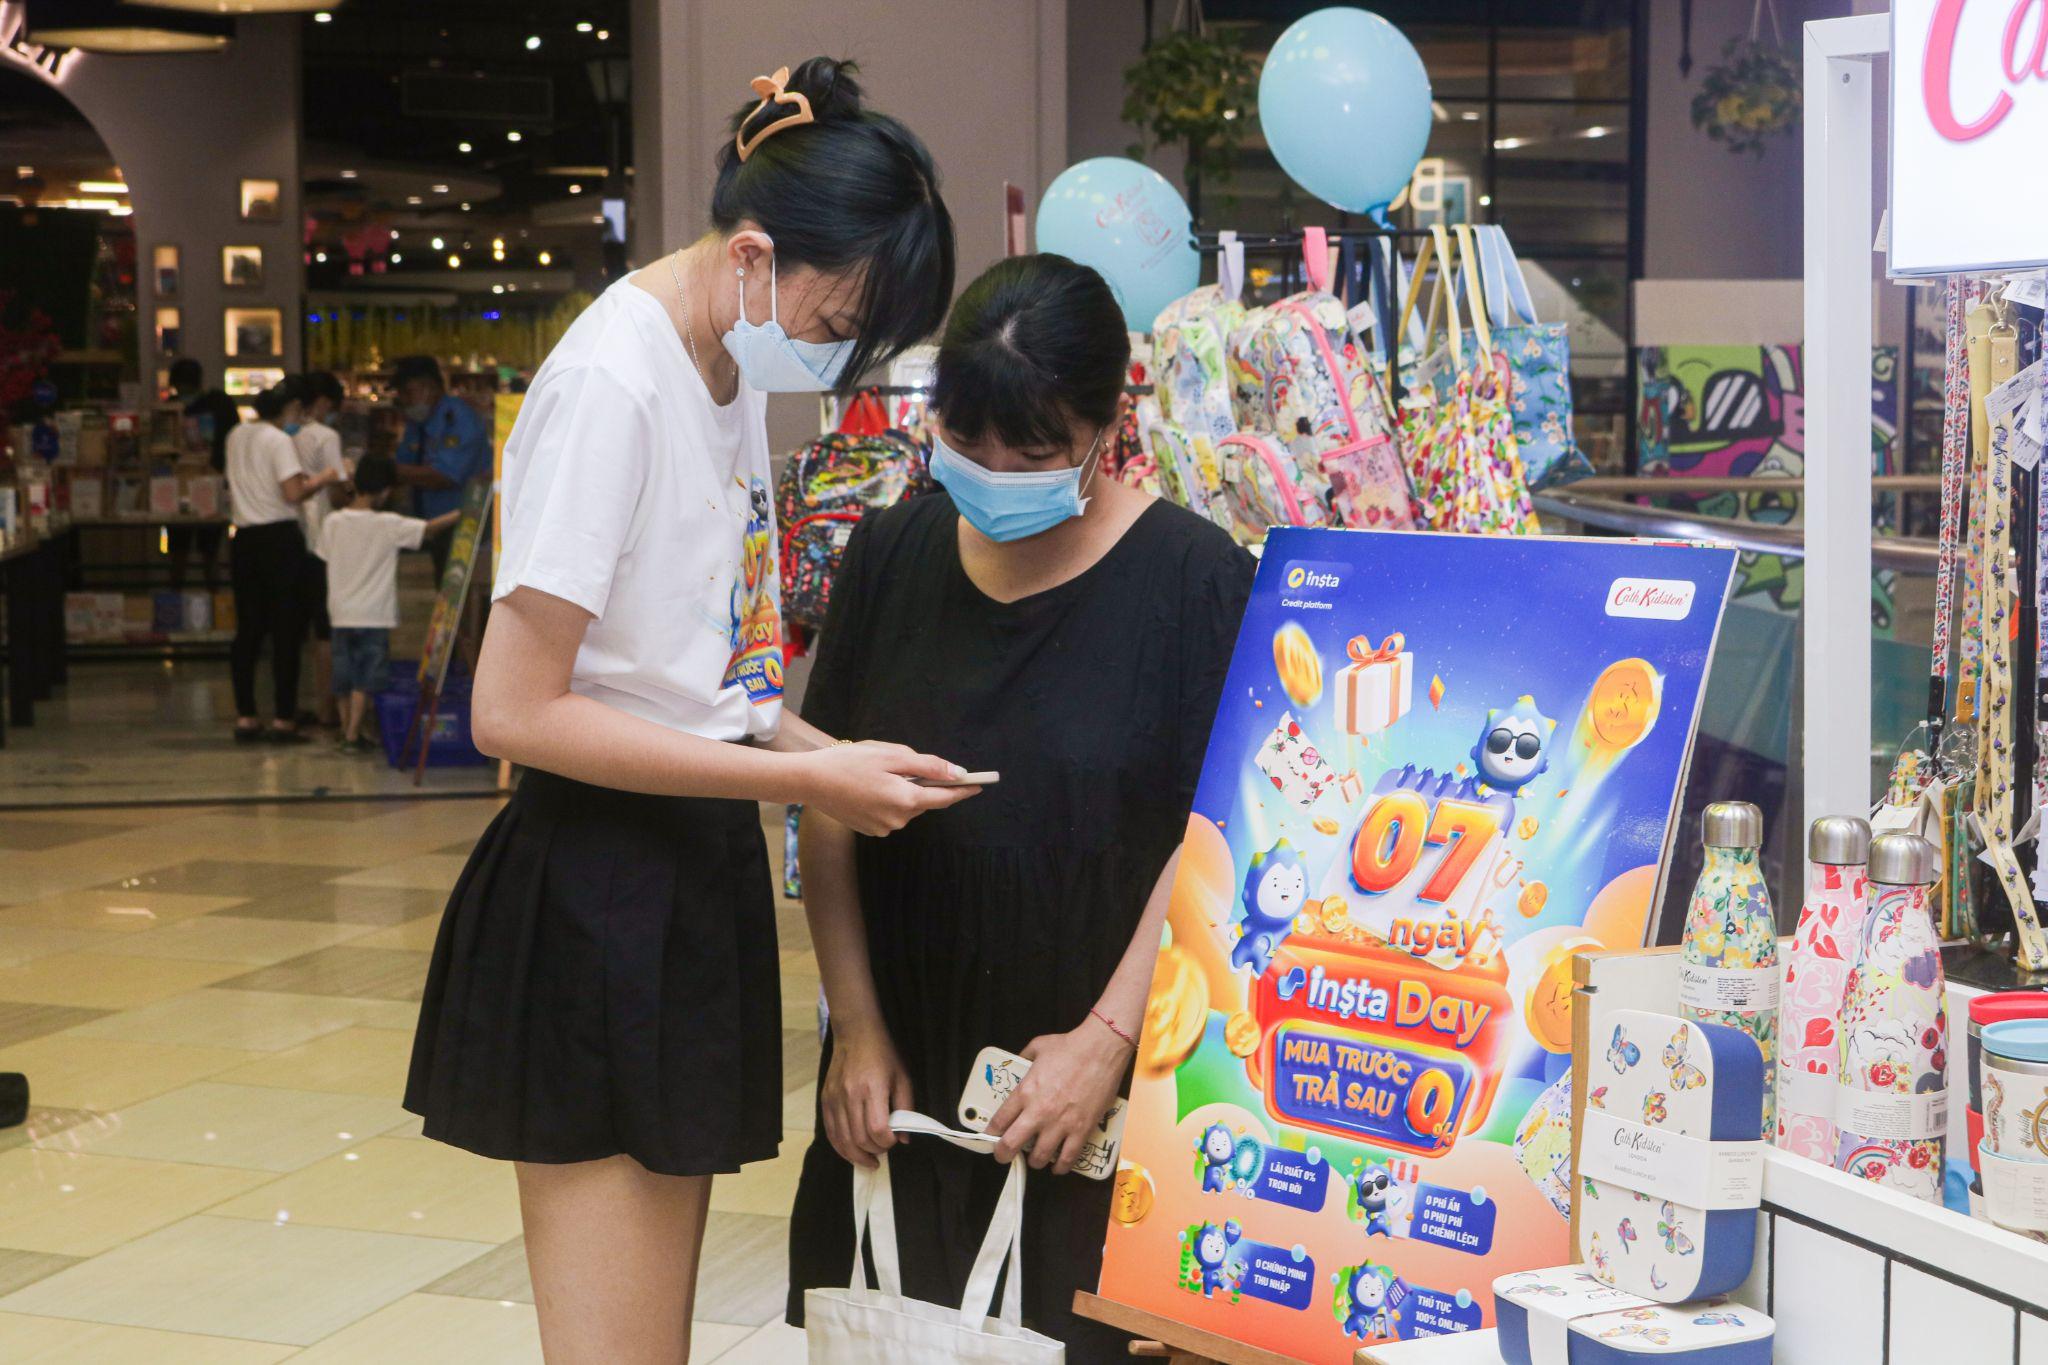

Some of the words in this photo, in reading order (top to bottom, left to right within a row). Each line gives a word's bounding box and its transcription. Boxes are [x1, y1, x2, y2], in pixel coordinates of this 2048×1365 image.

[1281, 598, 1303, 609] Credit
[1303, 601, 1333, 611] platform
[1615, 586, 1639, 606] Cath
[1639, 587, 1684, 607] Kidston
[1350, 788, 1503, 904] 07
[1388, 909, 1488, 958] ngày
[1396, 979, 1492, 1049] Day
[1284, 1039, 1331, 1067] MUA
[1335, 1045, 1413, 1087] TRƯỚC
[1292, 1070, 1340, 1106] TRẢ
[1344, 1082, 1397, 1119] SAU
[1614, 1127, 1633, 1147] Cath
[1631, 1132, 1663, 1155] Kidston
[1284, 1165, 1303, 1179] SUẤT
[1303, 1170, 1317, 1183] 0%
[1268, 1177, 1289, 1193] TRỌN
[1432, 1196, 1447, 1209] PHÍ
[1430, 1210, 1448, 1226] PHỤ
[1447, 1216, 1464, 1228] PHÍ
[1456, 1231, 1480, 1247] LỆCH
[1261, 1260, 1288, 1276] CHỨNG
[1287, 1267, 1308, 1282] MINH
[1254, 1273, 1270, 1287] THU
[1269, 1279, 1292, 1294] NHẬP
[1417, 1295, 1435, 1309] THỦ
[1435, 1300, 1453, 1315] TỤC
[1415, 1311, 1437, 1326] 100%
[1437, 1317, 1470, 1333] ONLINE
